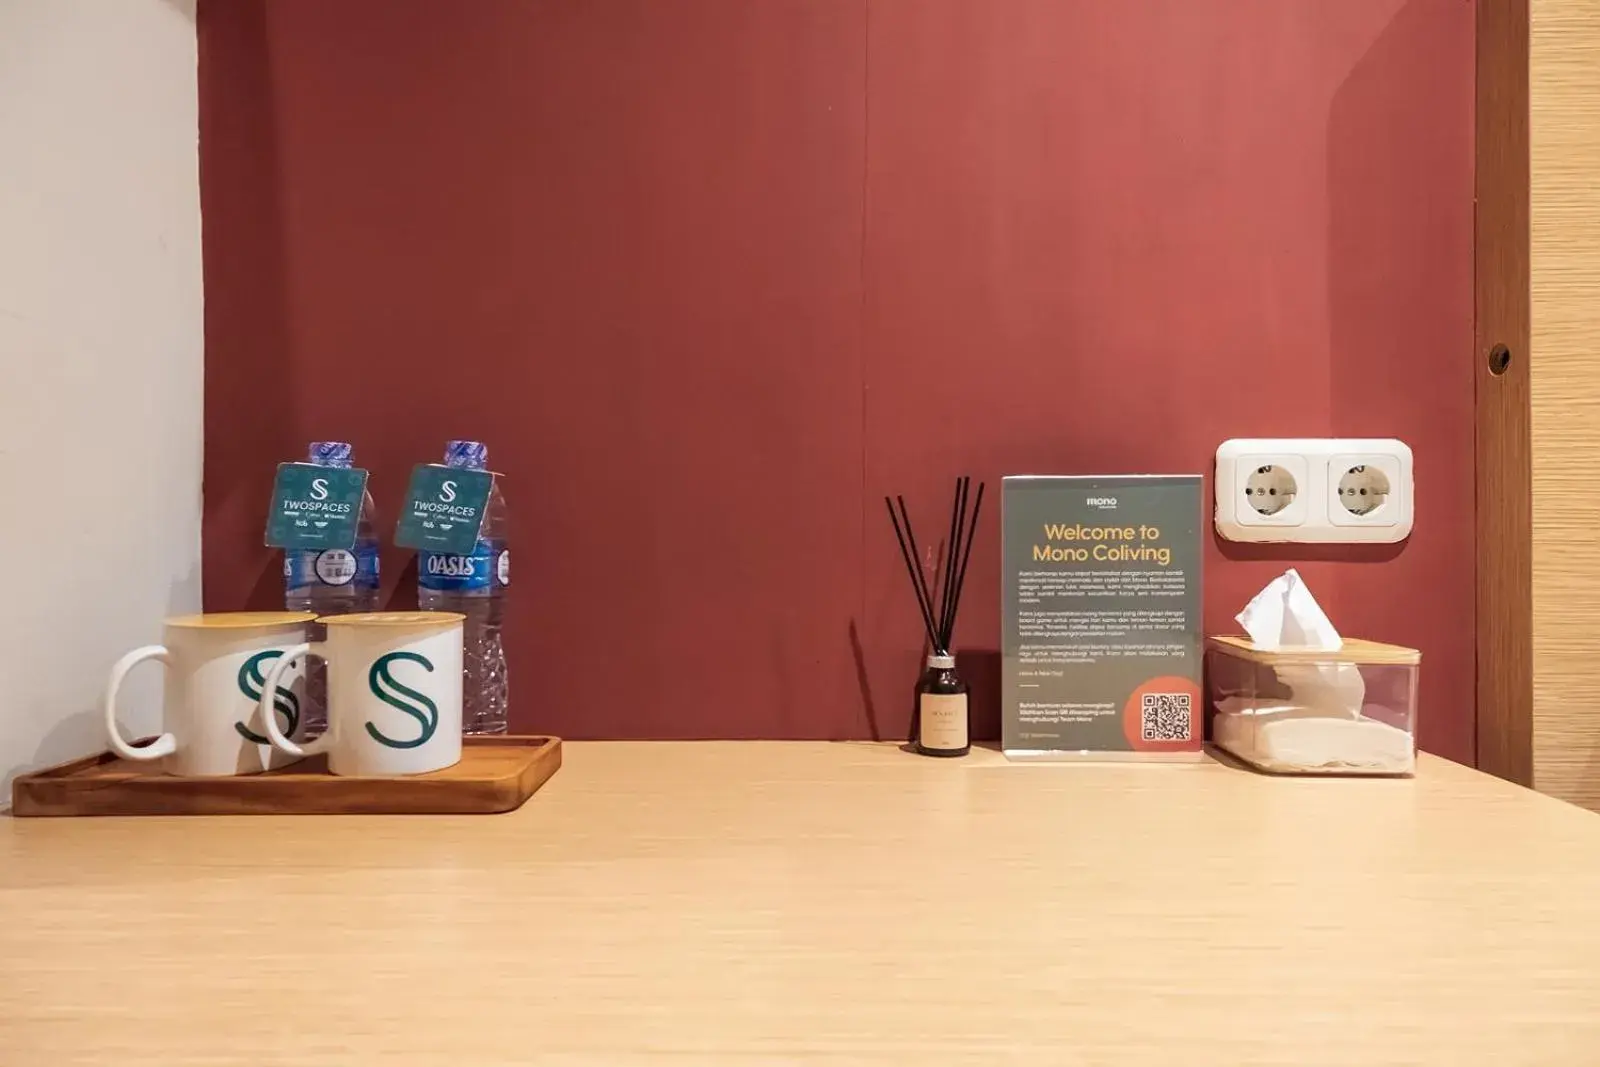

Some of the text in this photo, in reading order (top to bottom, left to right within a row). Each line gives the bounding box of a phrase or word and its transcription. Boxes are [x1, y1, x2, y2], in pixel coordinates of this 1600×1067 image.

[283, 500, 351, 513] TWOSPACES
[414, 501, 476, 517] TWOSPACES
[1086, 496, 1118, 506] mono
[1044, 523, 1160, 540] Welcome to
[1033, 543, 1171, 566] Mono Coliving
[427, 555, 475, 576] OASIS
[365, 651, 439, 749] S
